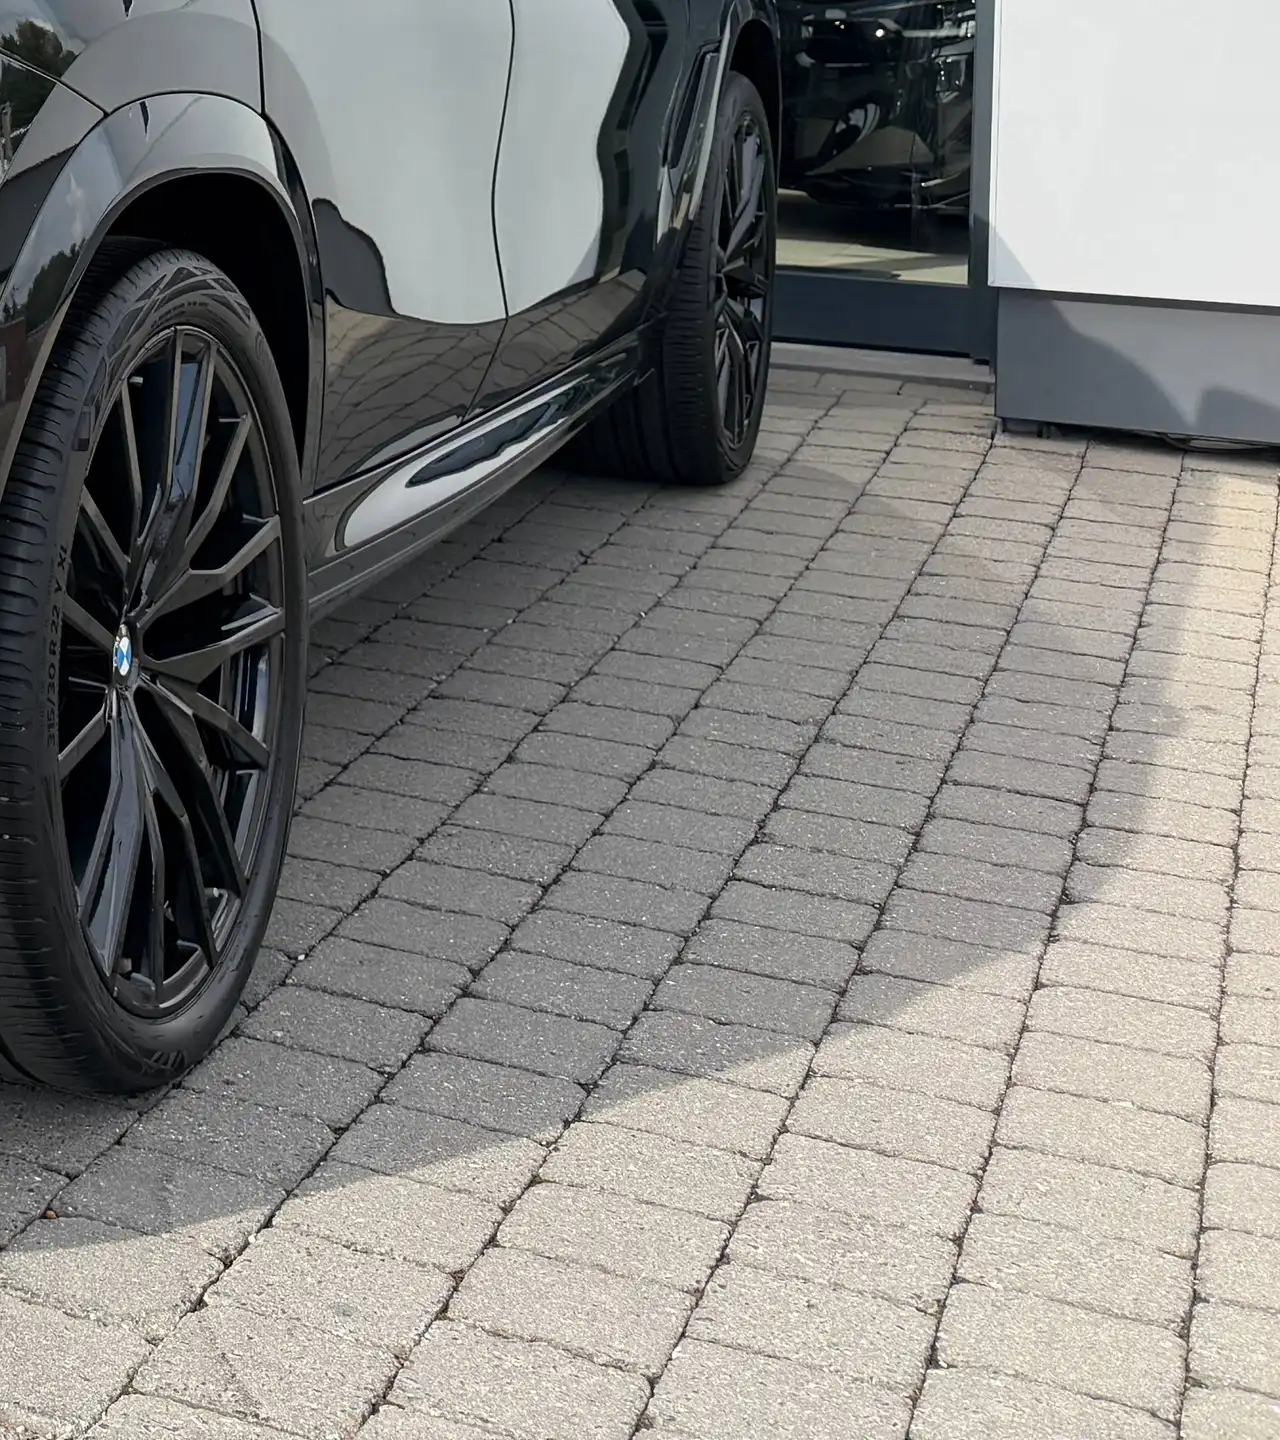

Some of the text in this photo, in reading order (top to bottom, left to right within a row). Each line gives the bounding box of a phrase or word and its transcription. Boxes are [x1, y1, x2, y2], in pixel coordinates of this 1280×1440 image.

[50, 604, 60, 634] 22
[48, 641, 58, 657] R
[46, 662, 57, 748] 315/30
